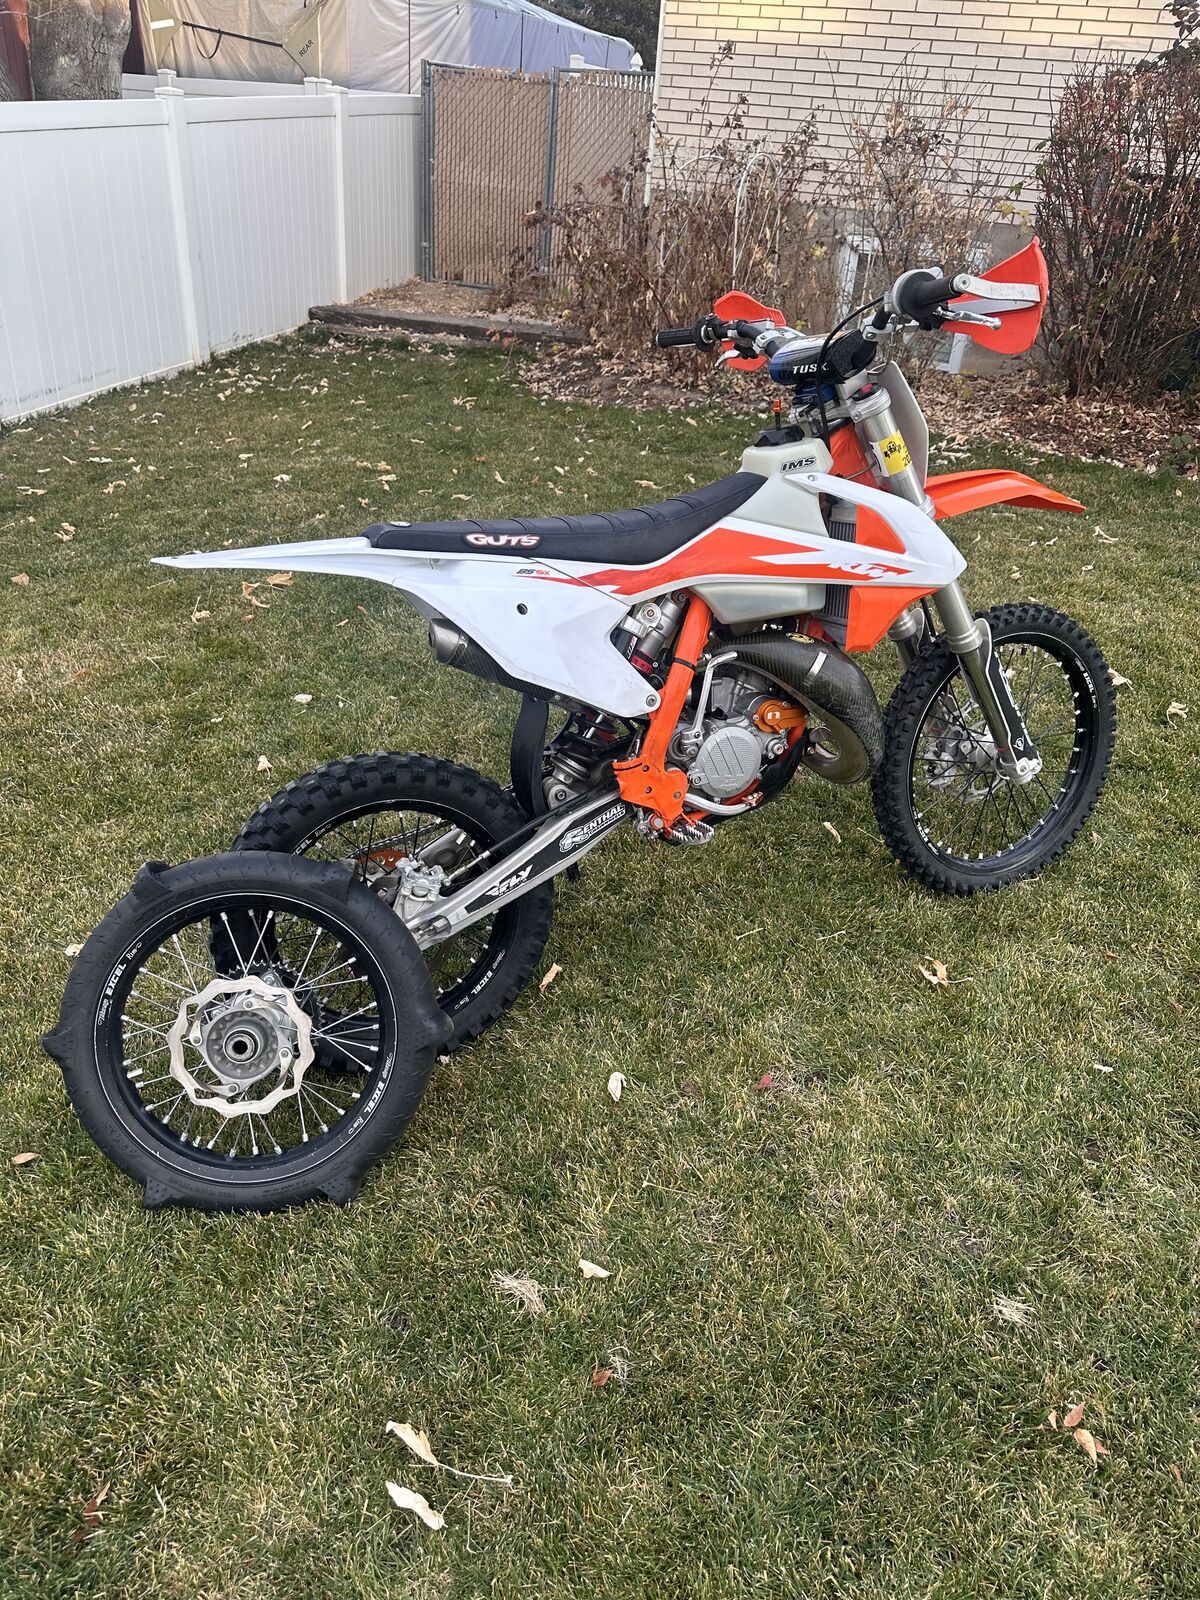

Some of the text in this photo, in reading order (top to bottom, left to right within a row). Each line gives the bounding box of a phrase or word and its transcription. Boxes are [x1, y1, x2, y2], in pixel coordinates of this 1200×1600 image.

[299, 40, 314, 57] REAR
[782, 457, 816, 471] IMS
[466, 533, 540, 546] GUTS
[827, 562, 899, 579] KTM
[560, 804, 625, 851] RENTHAL
[496, 864, 533, 894] FLY
[105, 963, 127, 997] EXCEL
[470, 970, 493, 995] EXCEL
[364, 1080, 385, 1113] EXCEL
